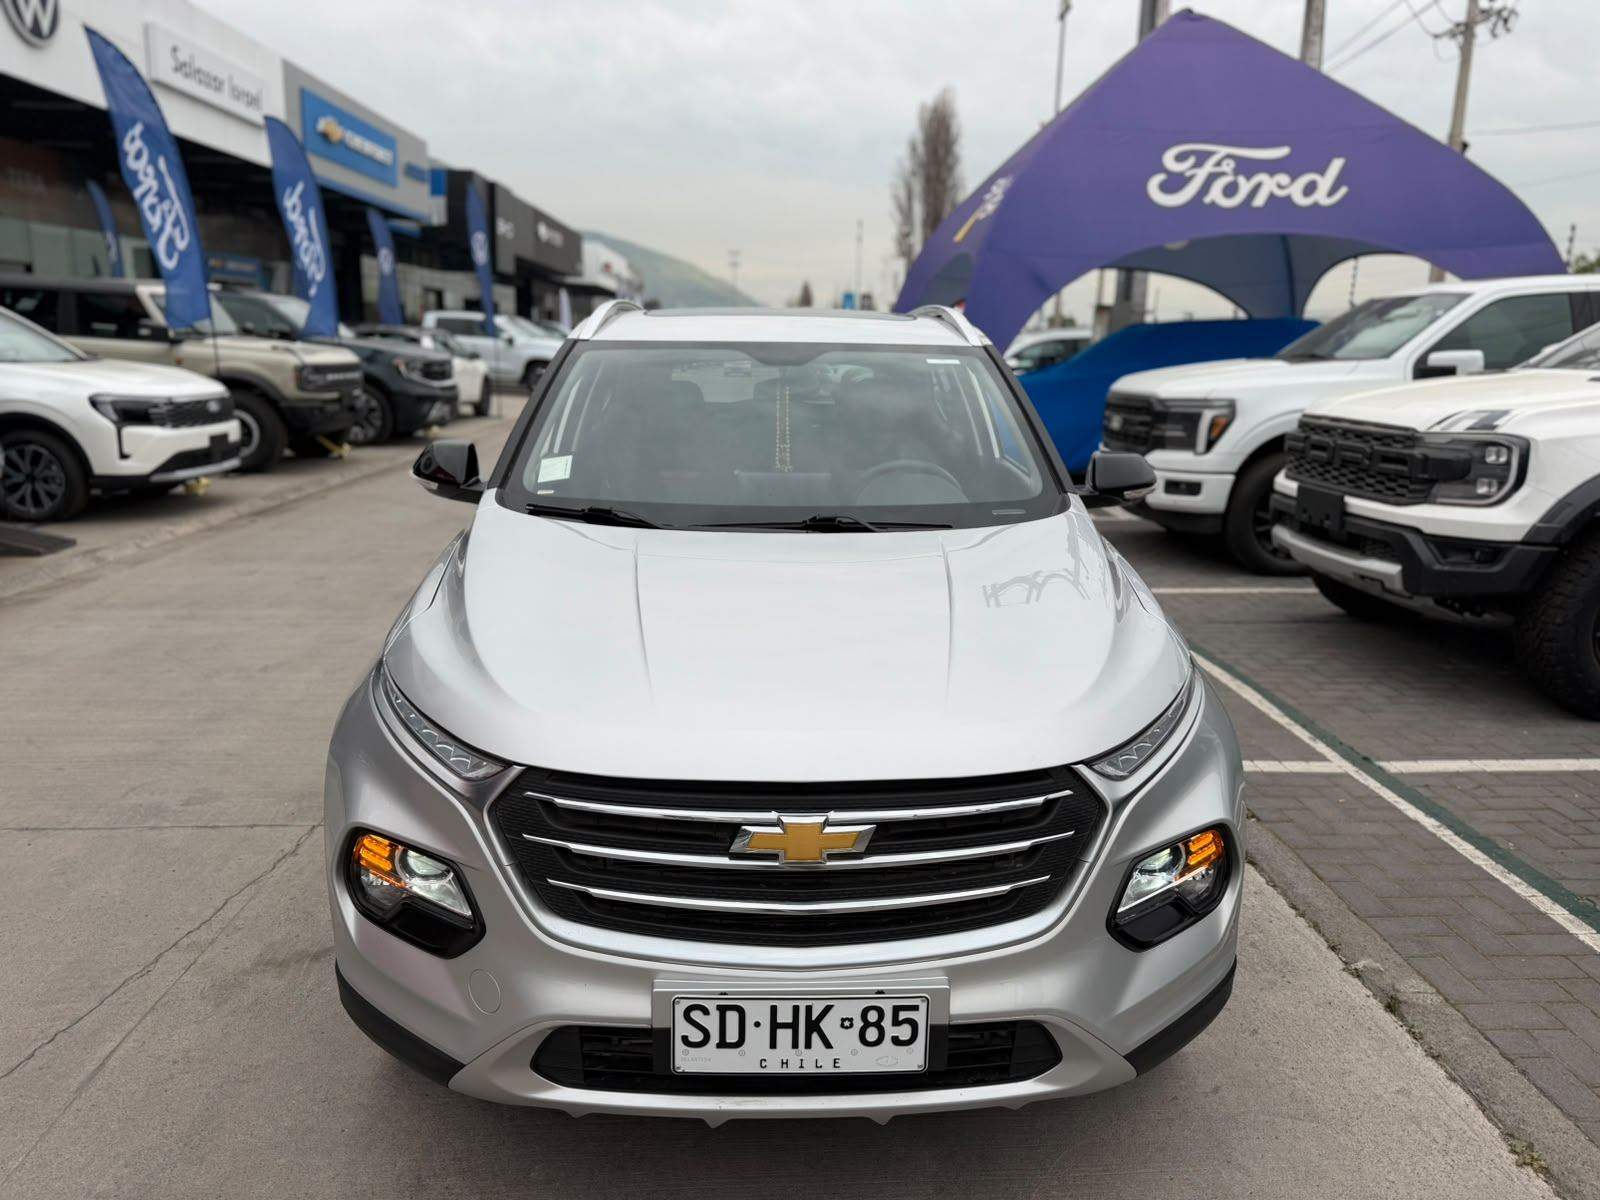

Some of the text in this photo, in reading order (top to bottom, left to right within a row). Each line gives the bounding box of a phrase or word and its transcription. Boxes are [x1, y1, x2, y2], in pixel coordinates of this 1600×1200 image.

[122, 122, 189, 270] Ford
[1147, 143, 1349, 208] Ford
[759, 1057, 841, 1069] CHILE
